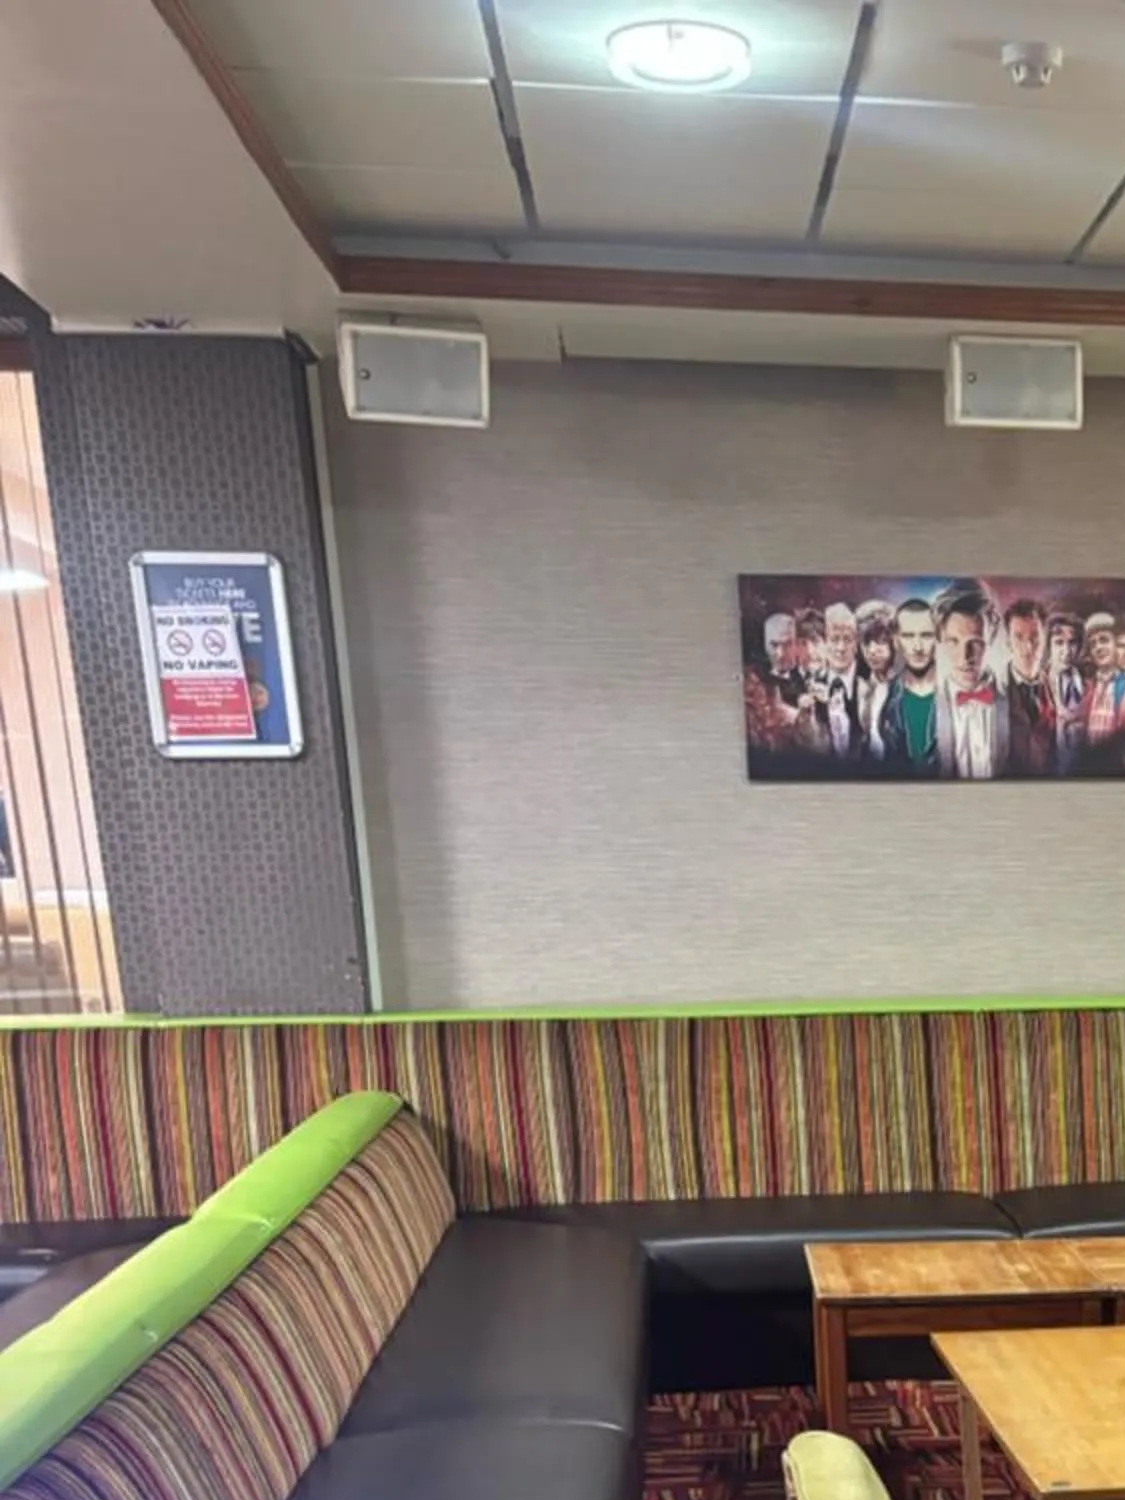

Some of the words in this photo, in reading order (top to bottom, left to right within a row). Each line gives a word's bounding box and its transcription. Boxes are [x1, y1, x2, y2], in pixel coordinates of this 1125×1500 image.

[156, 615, 175, 626] NO
[177, 614, 230, 626] SMOKING
[163, 660, 184, 670] NO
[187, 659, 238, 670] VAPING
